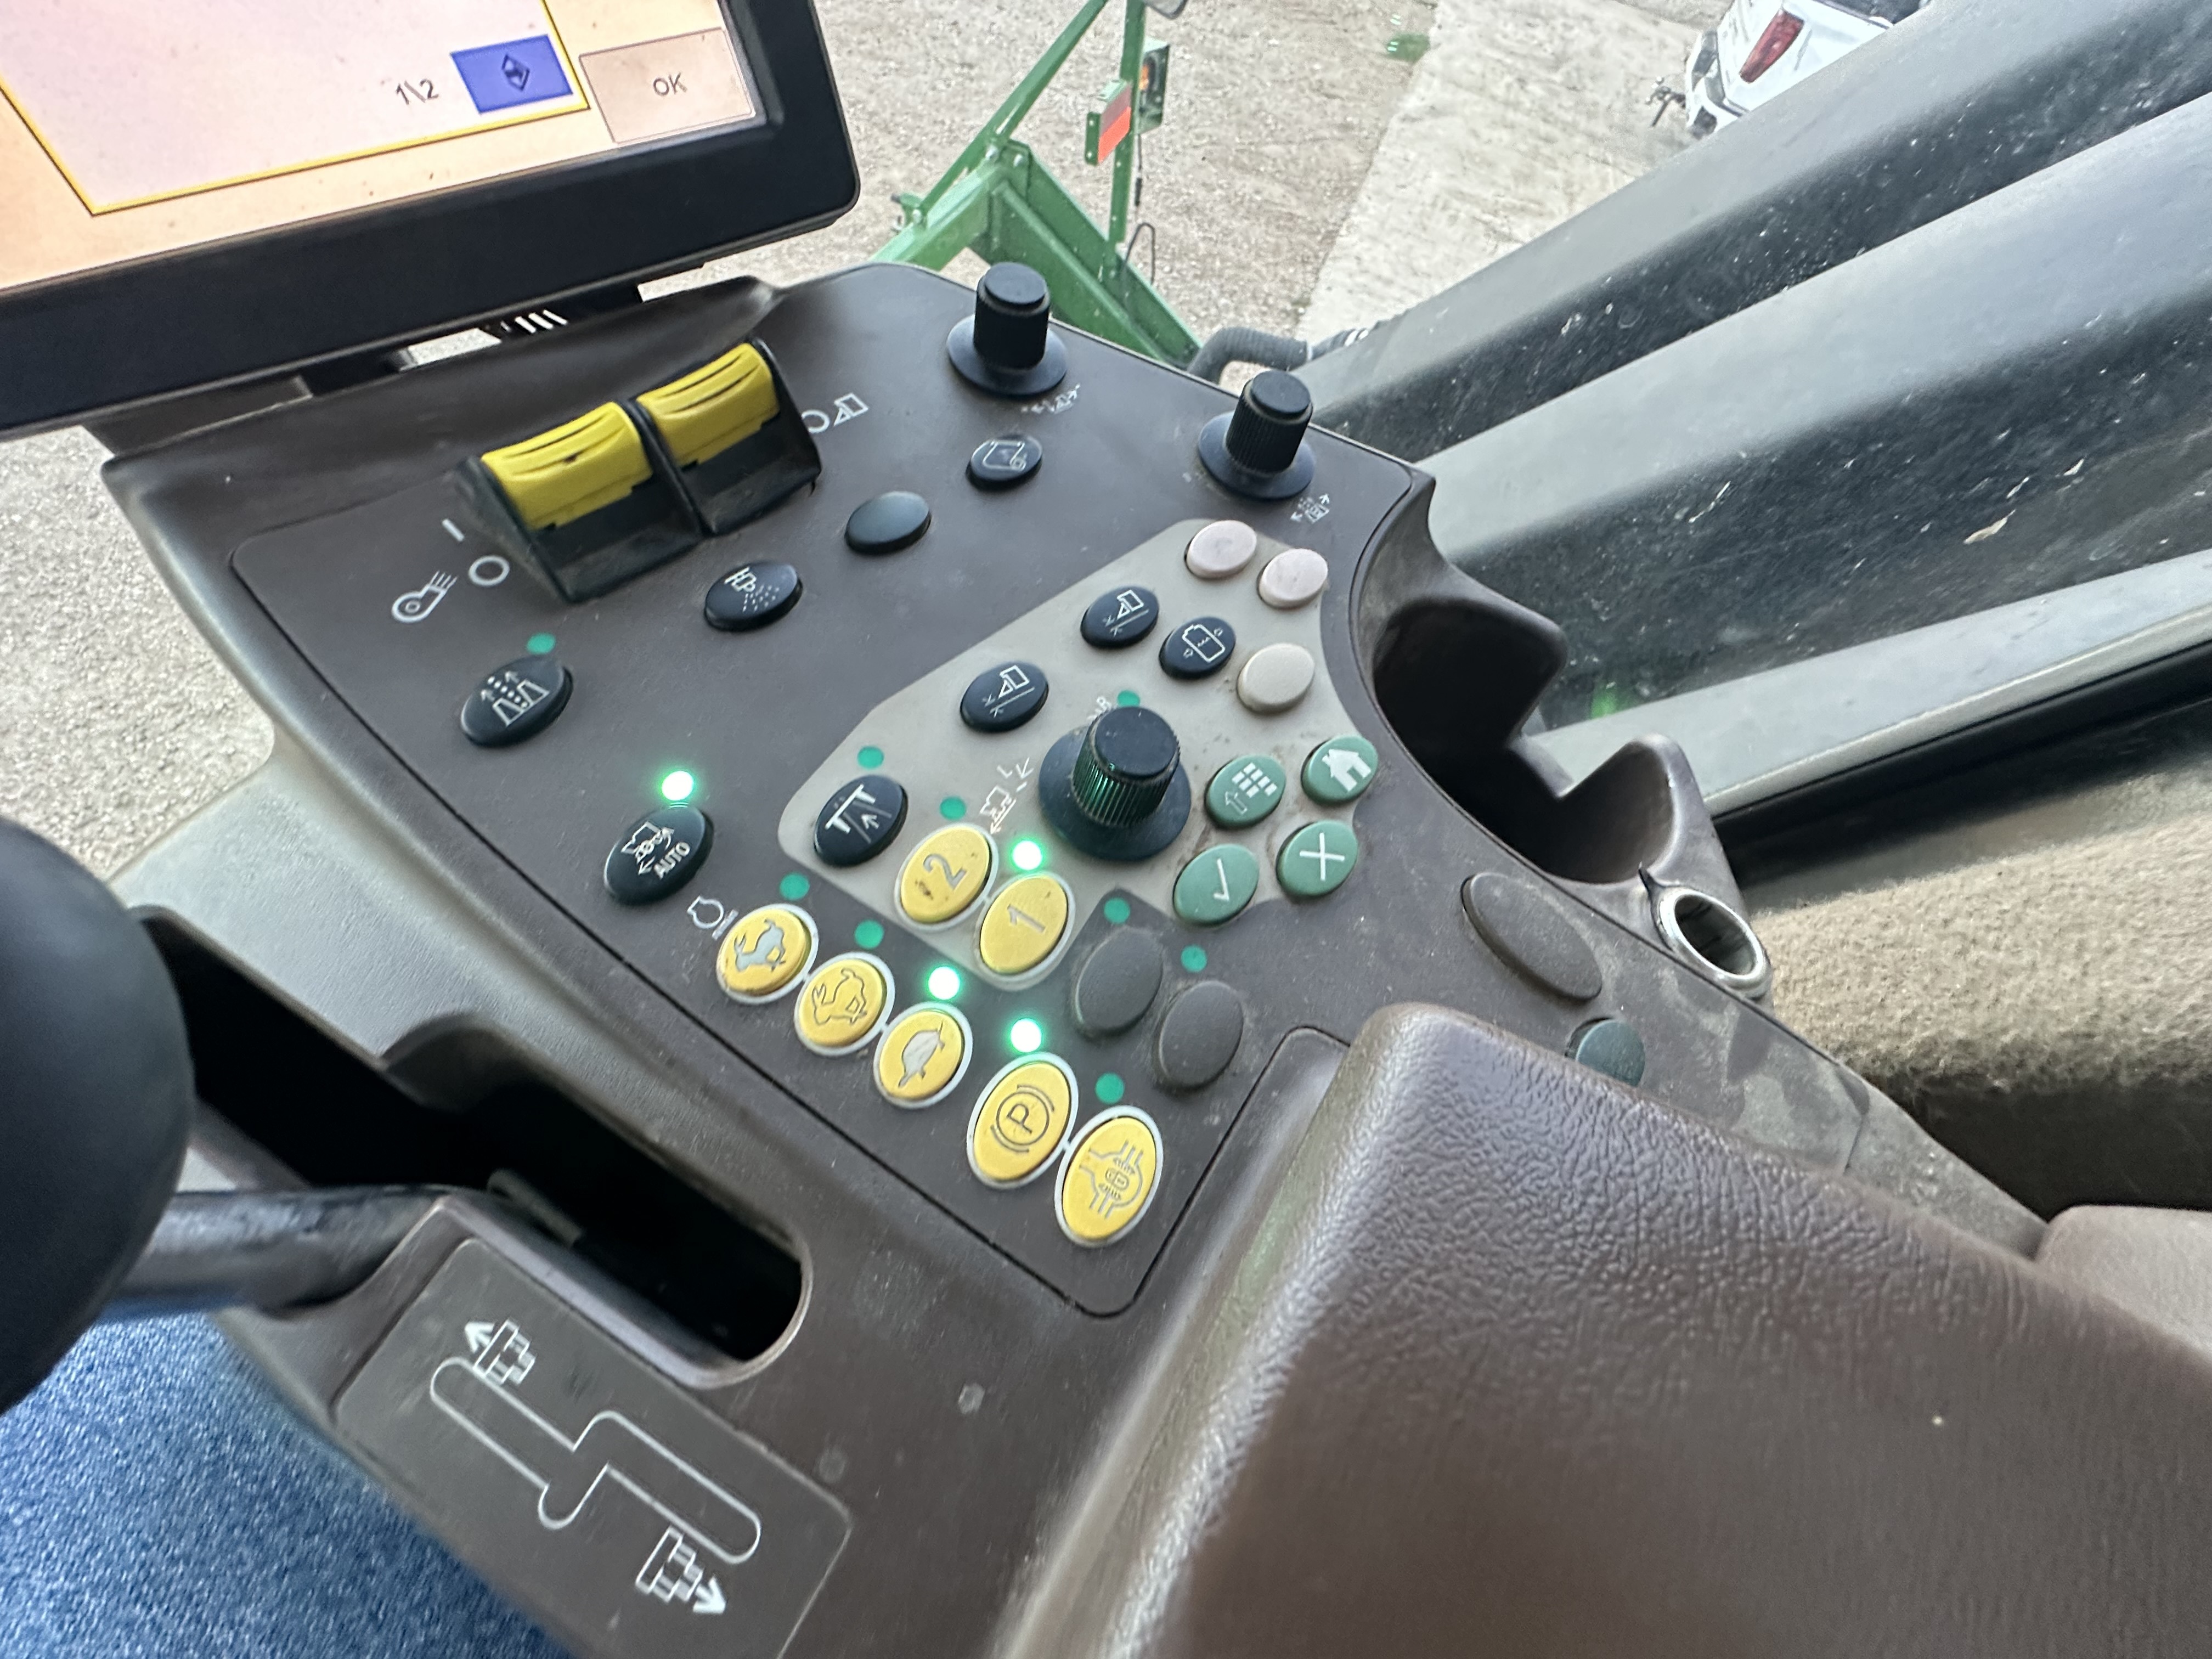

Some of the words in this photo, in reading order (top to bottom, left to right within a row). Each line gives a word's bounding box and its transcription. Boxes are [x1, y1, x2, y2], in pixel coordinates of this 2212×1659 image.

[653, 72, 687, 97] OK
[654, 842, 690, 880] AUTO
[923, 854, 967, 890] 2
[1007, 904, 1046, 933] 1
[1007, 1103, 1032, 1134] P
